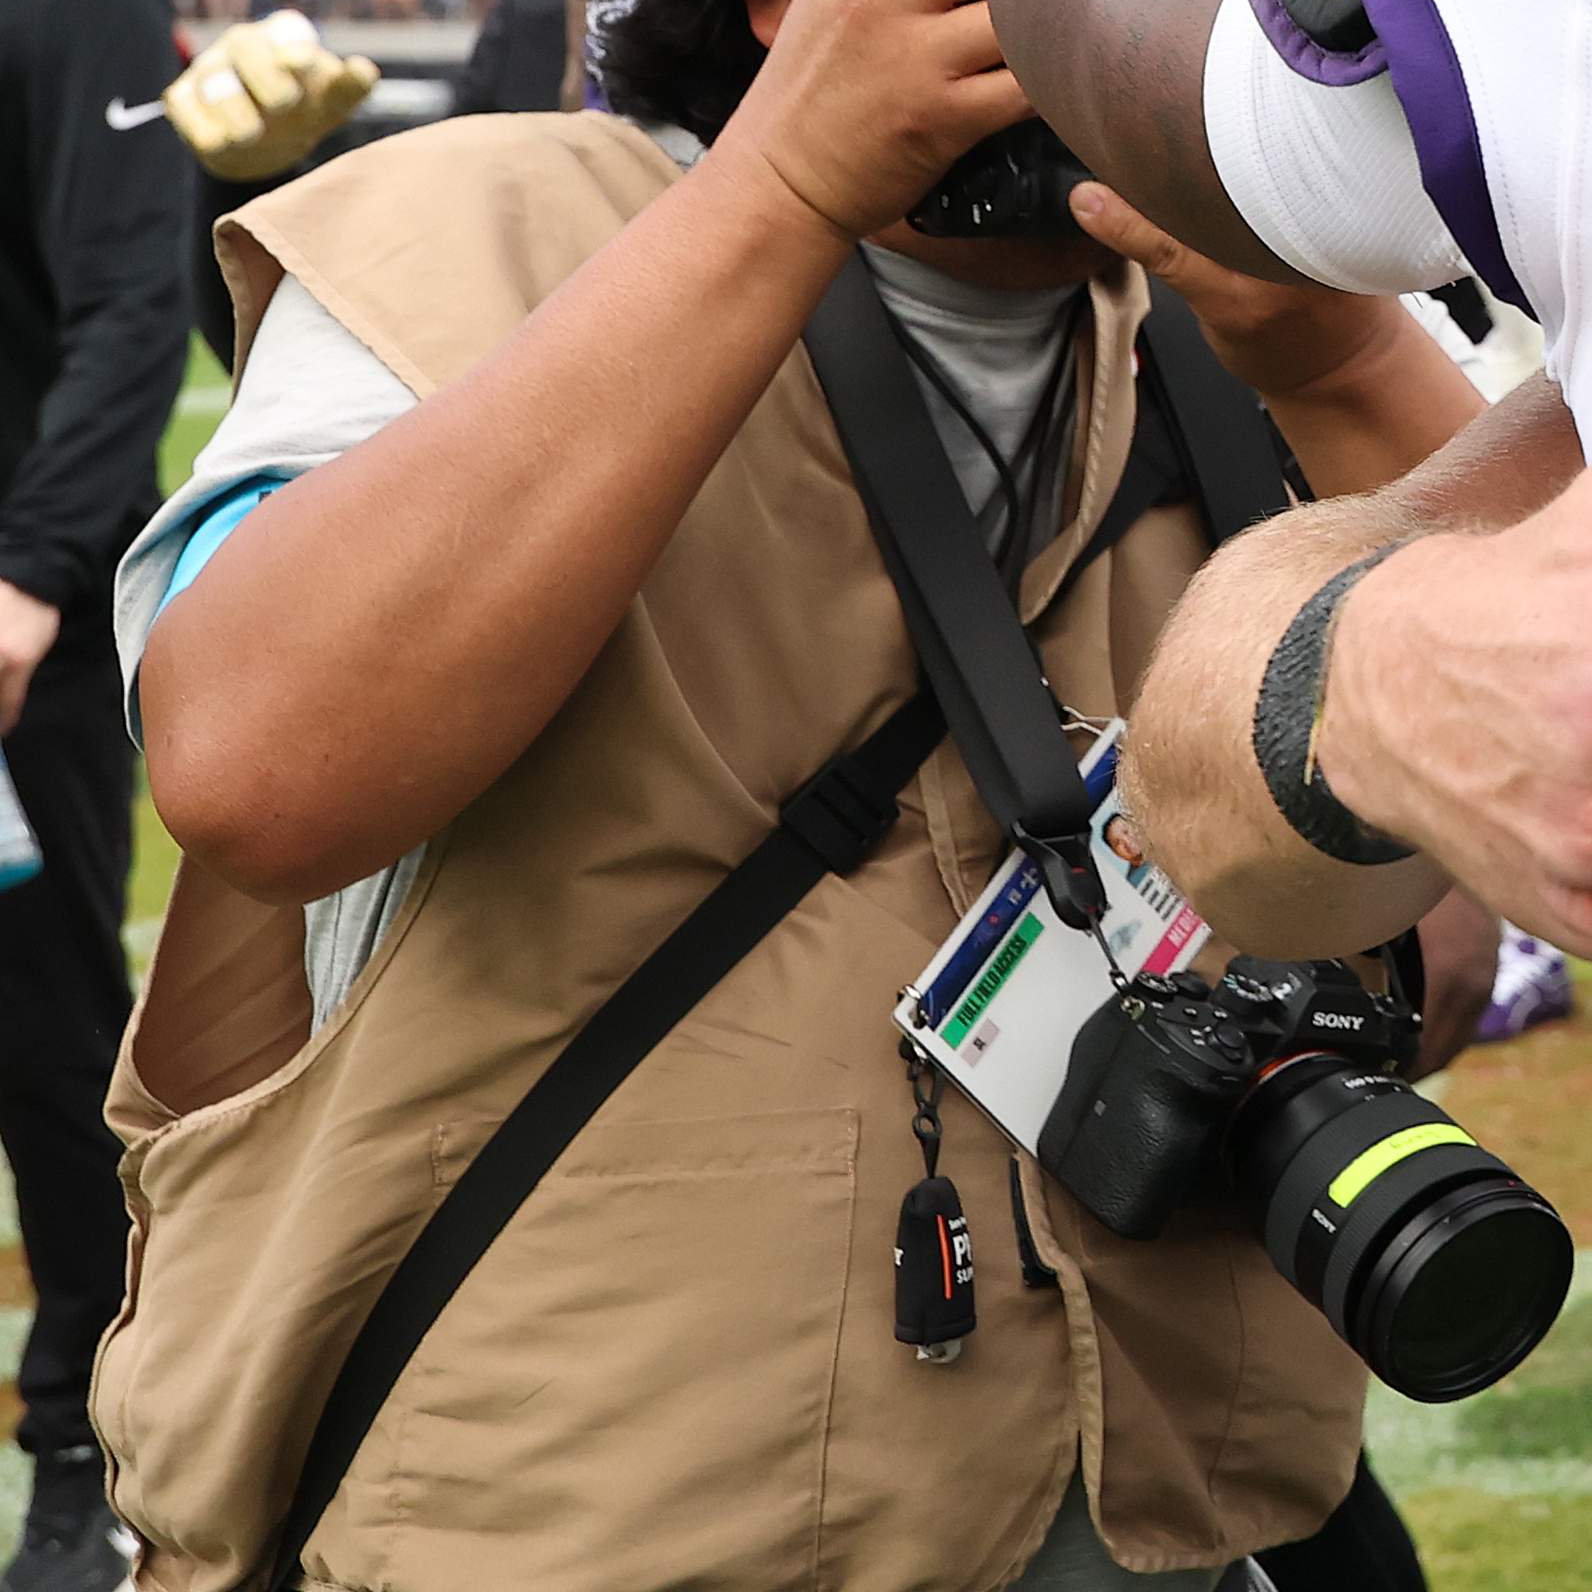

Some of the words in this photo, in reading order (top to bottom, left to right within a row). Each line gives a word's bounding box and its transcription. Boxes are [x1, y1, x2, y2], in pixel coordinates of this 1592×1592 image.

[956, 998, 982, 1025] FULL
[972, 971, 1003, 1002] FIELD
[991, 935, 1028, 974] ACCESS
[1312, 1010, 1365, 1031] SONY
[1311, 1208, 1337, 1234] SONY
